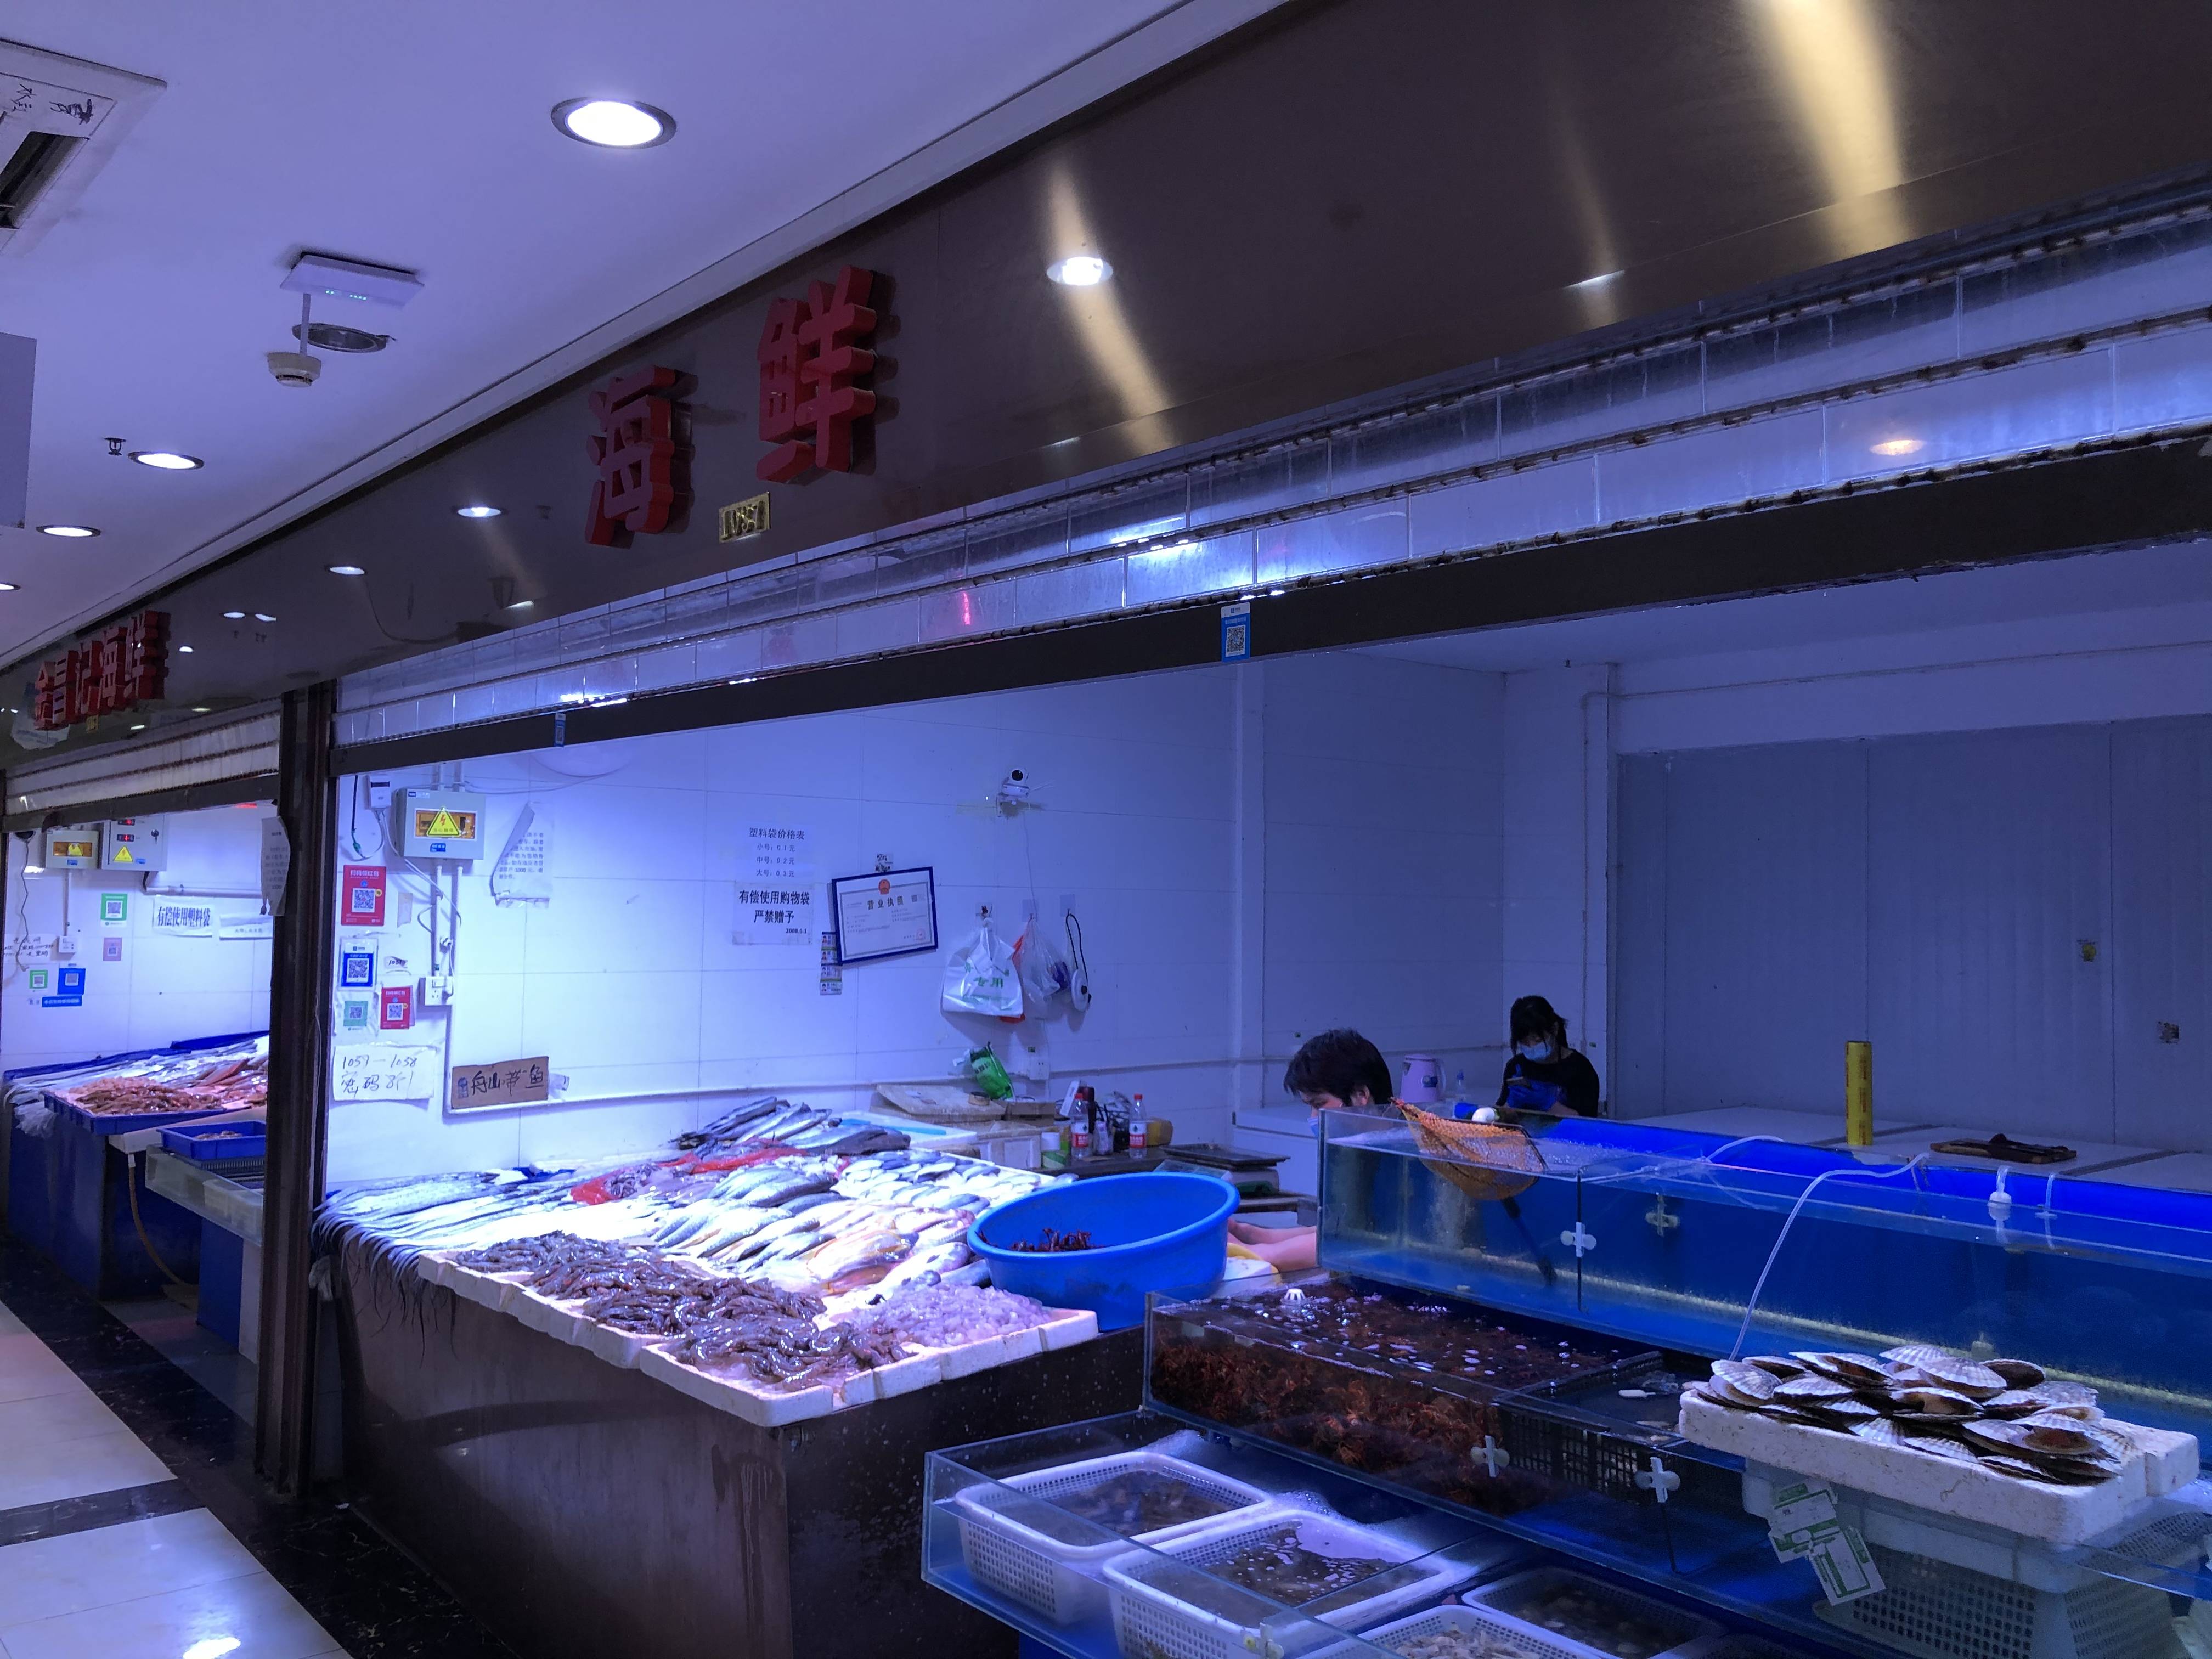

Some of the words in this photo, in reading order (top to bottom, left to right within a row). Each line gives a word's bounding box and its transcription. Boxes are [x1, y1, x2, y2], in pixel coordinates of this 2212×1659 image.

[585, 264, 877, 546] 海鲜
[749, 827, 805, 840] 塑料袋价格表
[738, 889, 810, 905] 有偿使用购物袋
[867, 895, 904, 910] 营业执照
[157, 906, 211, 927] 有偿使用塑料袋
[753, 910, 794, 924] 严禁赠予
